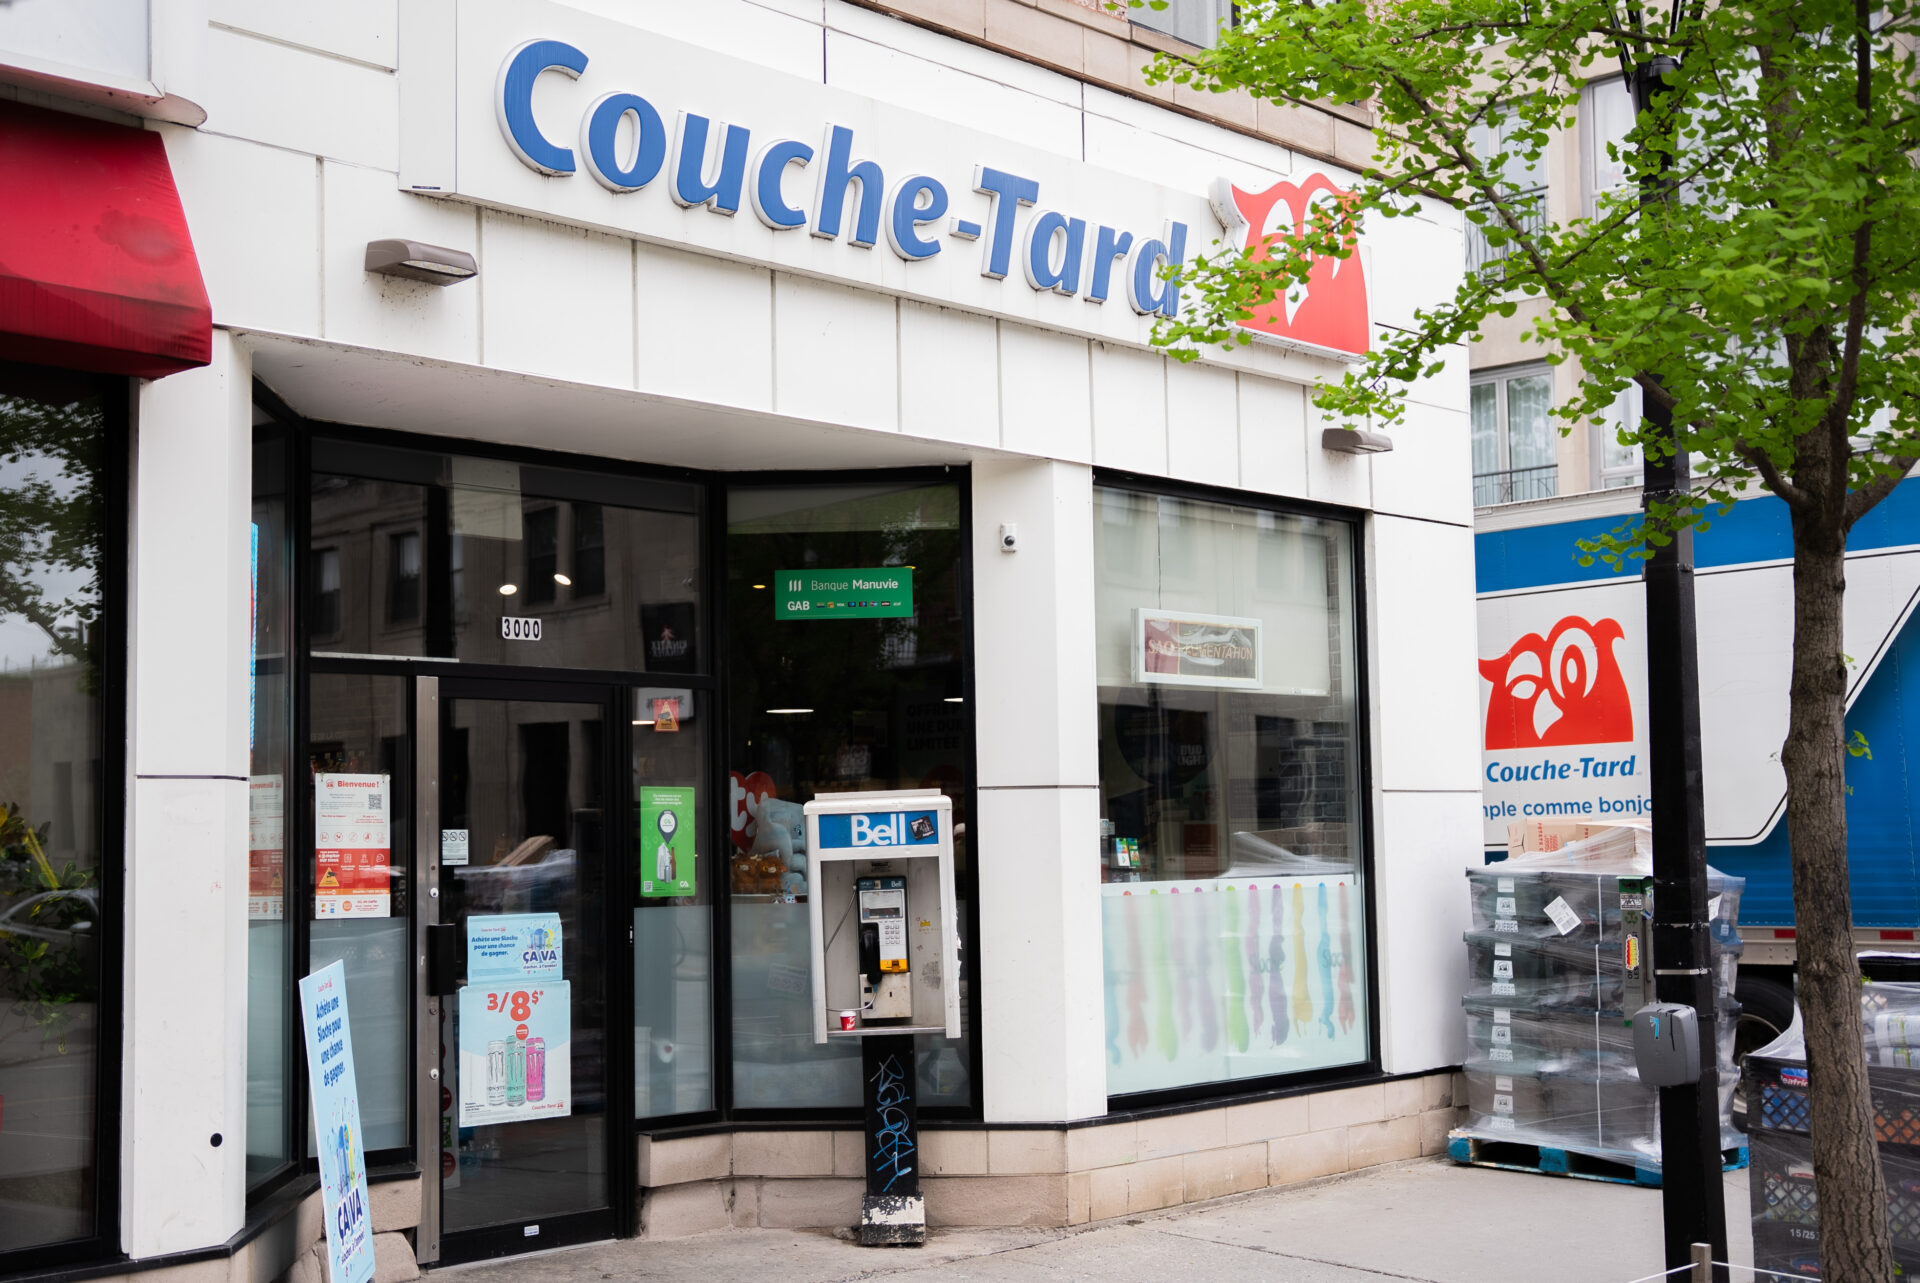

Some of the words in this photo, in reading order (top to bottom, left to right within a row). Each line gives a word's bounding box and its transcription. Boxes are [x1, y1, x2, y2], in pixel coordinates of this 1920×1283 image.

[496, 38, 1188, 318] Couche-Tard
[811, 580, 849, 591] Banque
[852, 578, 899, 590] Manuvie
[787, 600, 811, 611] GAB
[504, 618, 540, 638] 3000
[1486, 755, 1636, 783] Couche-Tard
[1523, 801, 1592, 816] comme
[851, 813, 906, 846] Bell
[891, 880, 902, 888] Bell
[523, 951, 538, 964] ÇA
[540, 950, 557, 961] VA
[331, 996, 339, 1011] une
[317, 1021, 332, 1043] Sloche
[332, 1017, 341, 1038] pour
[321, 1049, 329, 1065] une
[330, 1041, 343, 1058] chance
[324, 1069, 329, 1087] de
[338, 1202, 350, 1246] ÇA
[349, 1188, 362, 1225] VA
